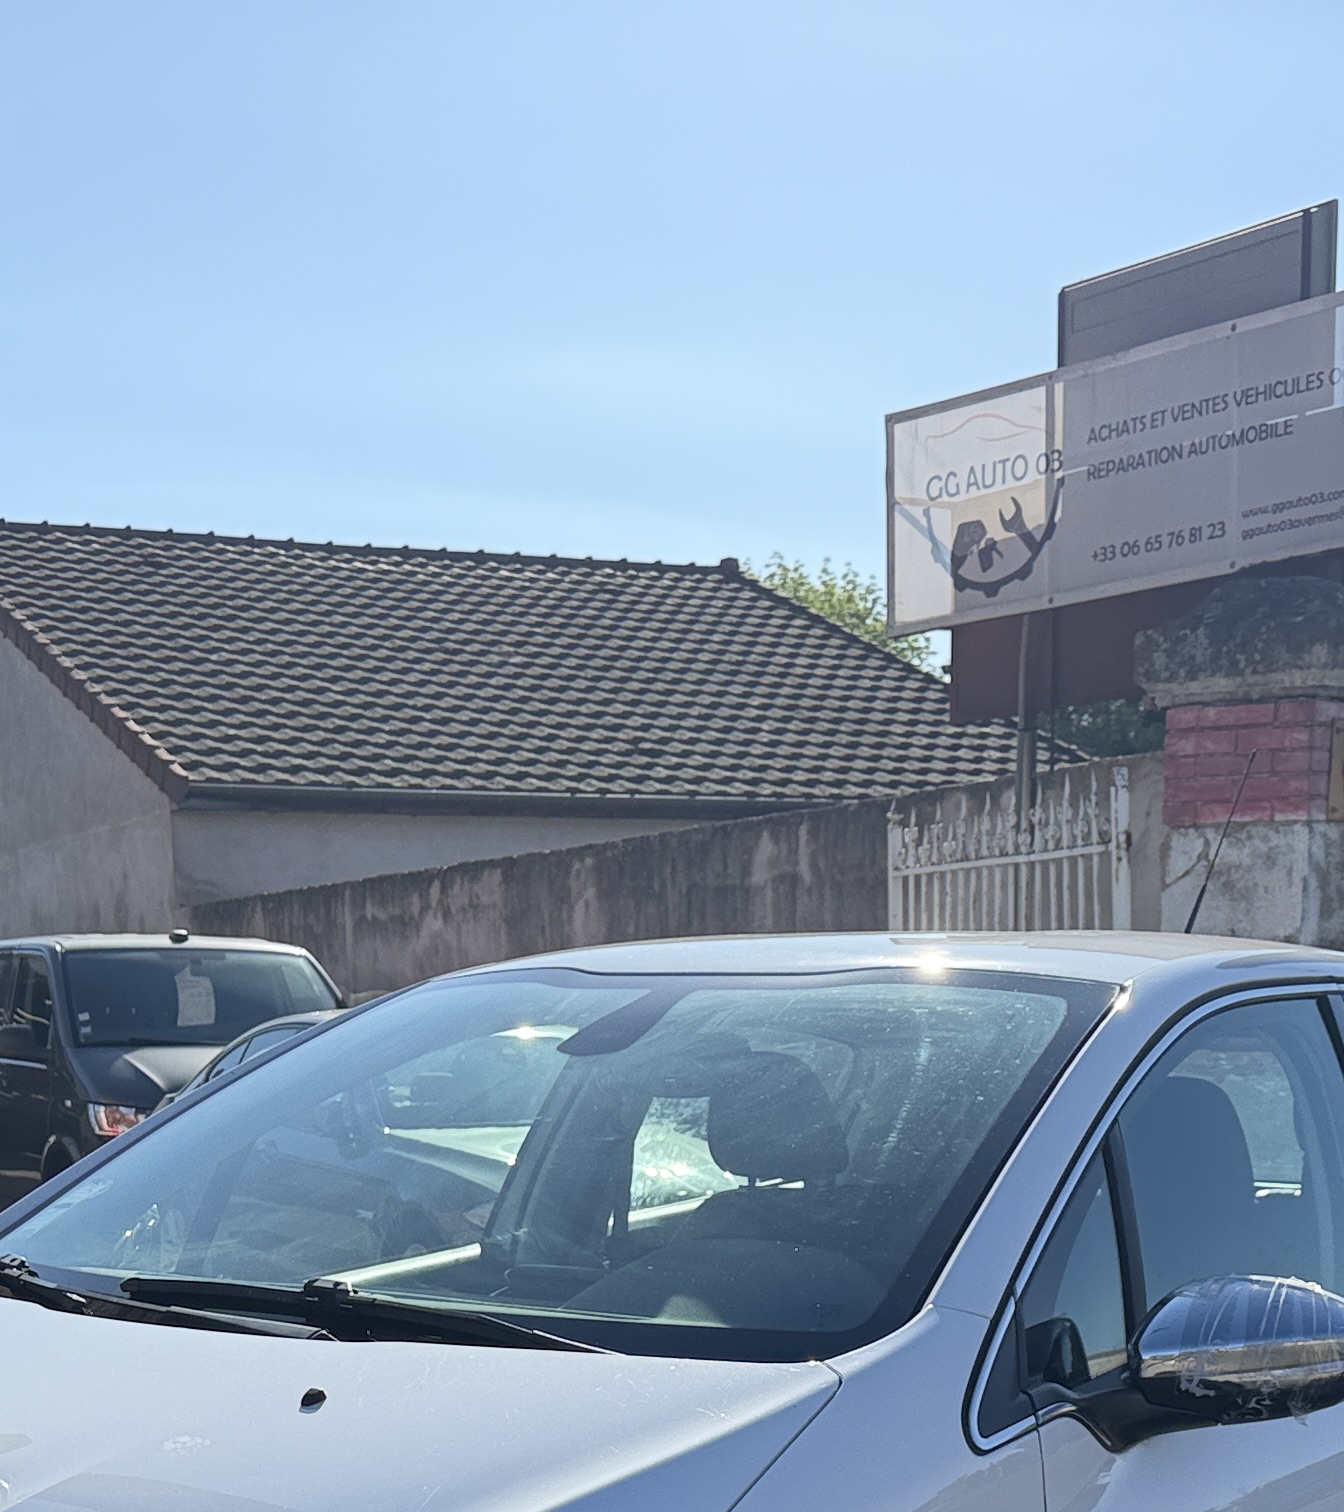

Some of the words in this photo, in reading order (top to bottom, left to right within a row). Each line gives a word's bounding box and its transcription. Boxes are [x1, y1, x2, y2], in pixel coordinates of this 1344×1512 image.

[1086, 414, 1147, 445] ACHATS
[1150, 409, 1168, 430] ET
[1170, 393, 1229, 424] VENTES
[1233, 371, 1325, 408] VEHICULES
[925, 471, 961, 502] GG
[966, 453, 1029, 494] AUTO
[1035, 448, 1065, 477] 03
[1086, 442, 1184, 482] REPARATION
[1186, 418, 1295, 459] AUTOMOBILE
[1090, 544, 1117, 563] +33
[1119, 539, 1141, 558] 06
[1143, 534, 1163, 553] 65
[1166, 529, 1185, 549] 76
[1188, 525, 1203, 544] 81
[1206, 521, 1227, 541] 23
